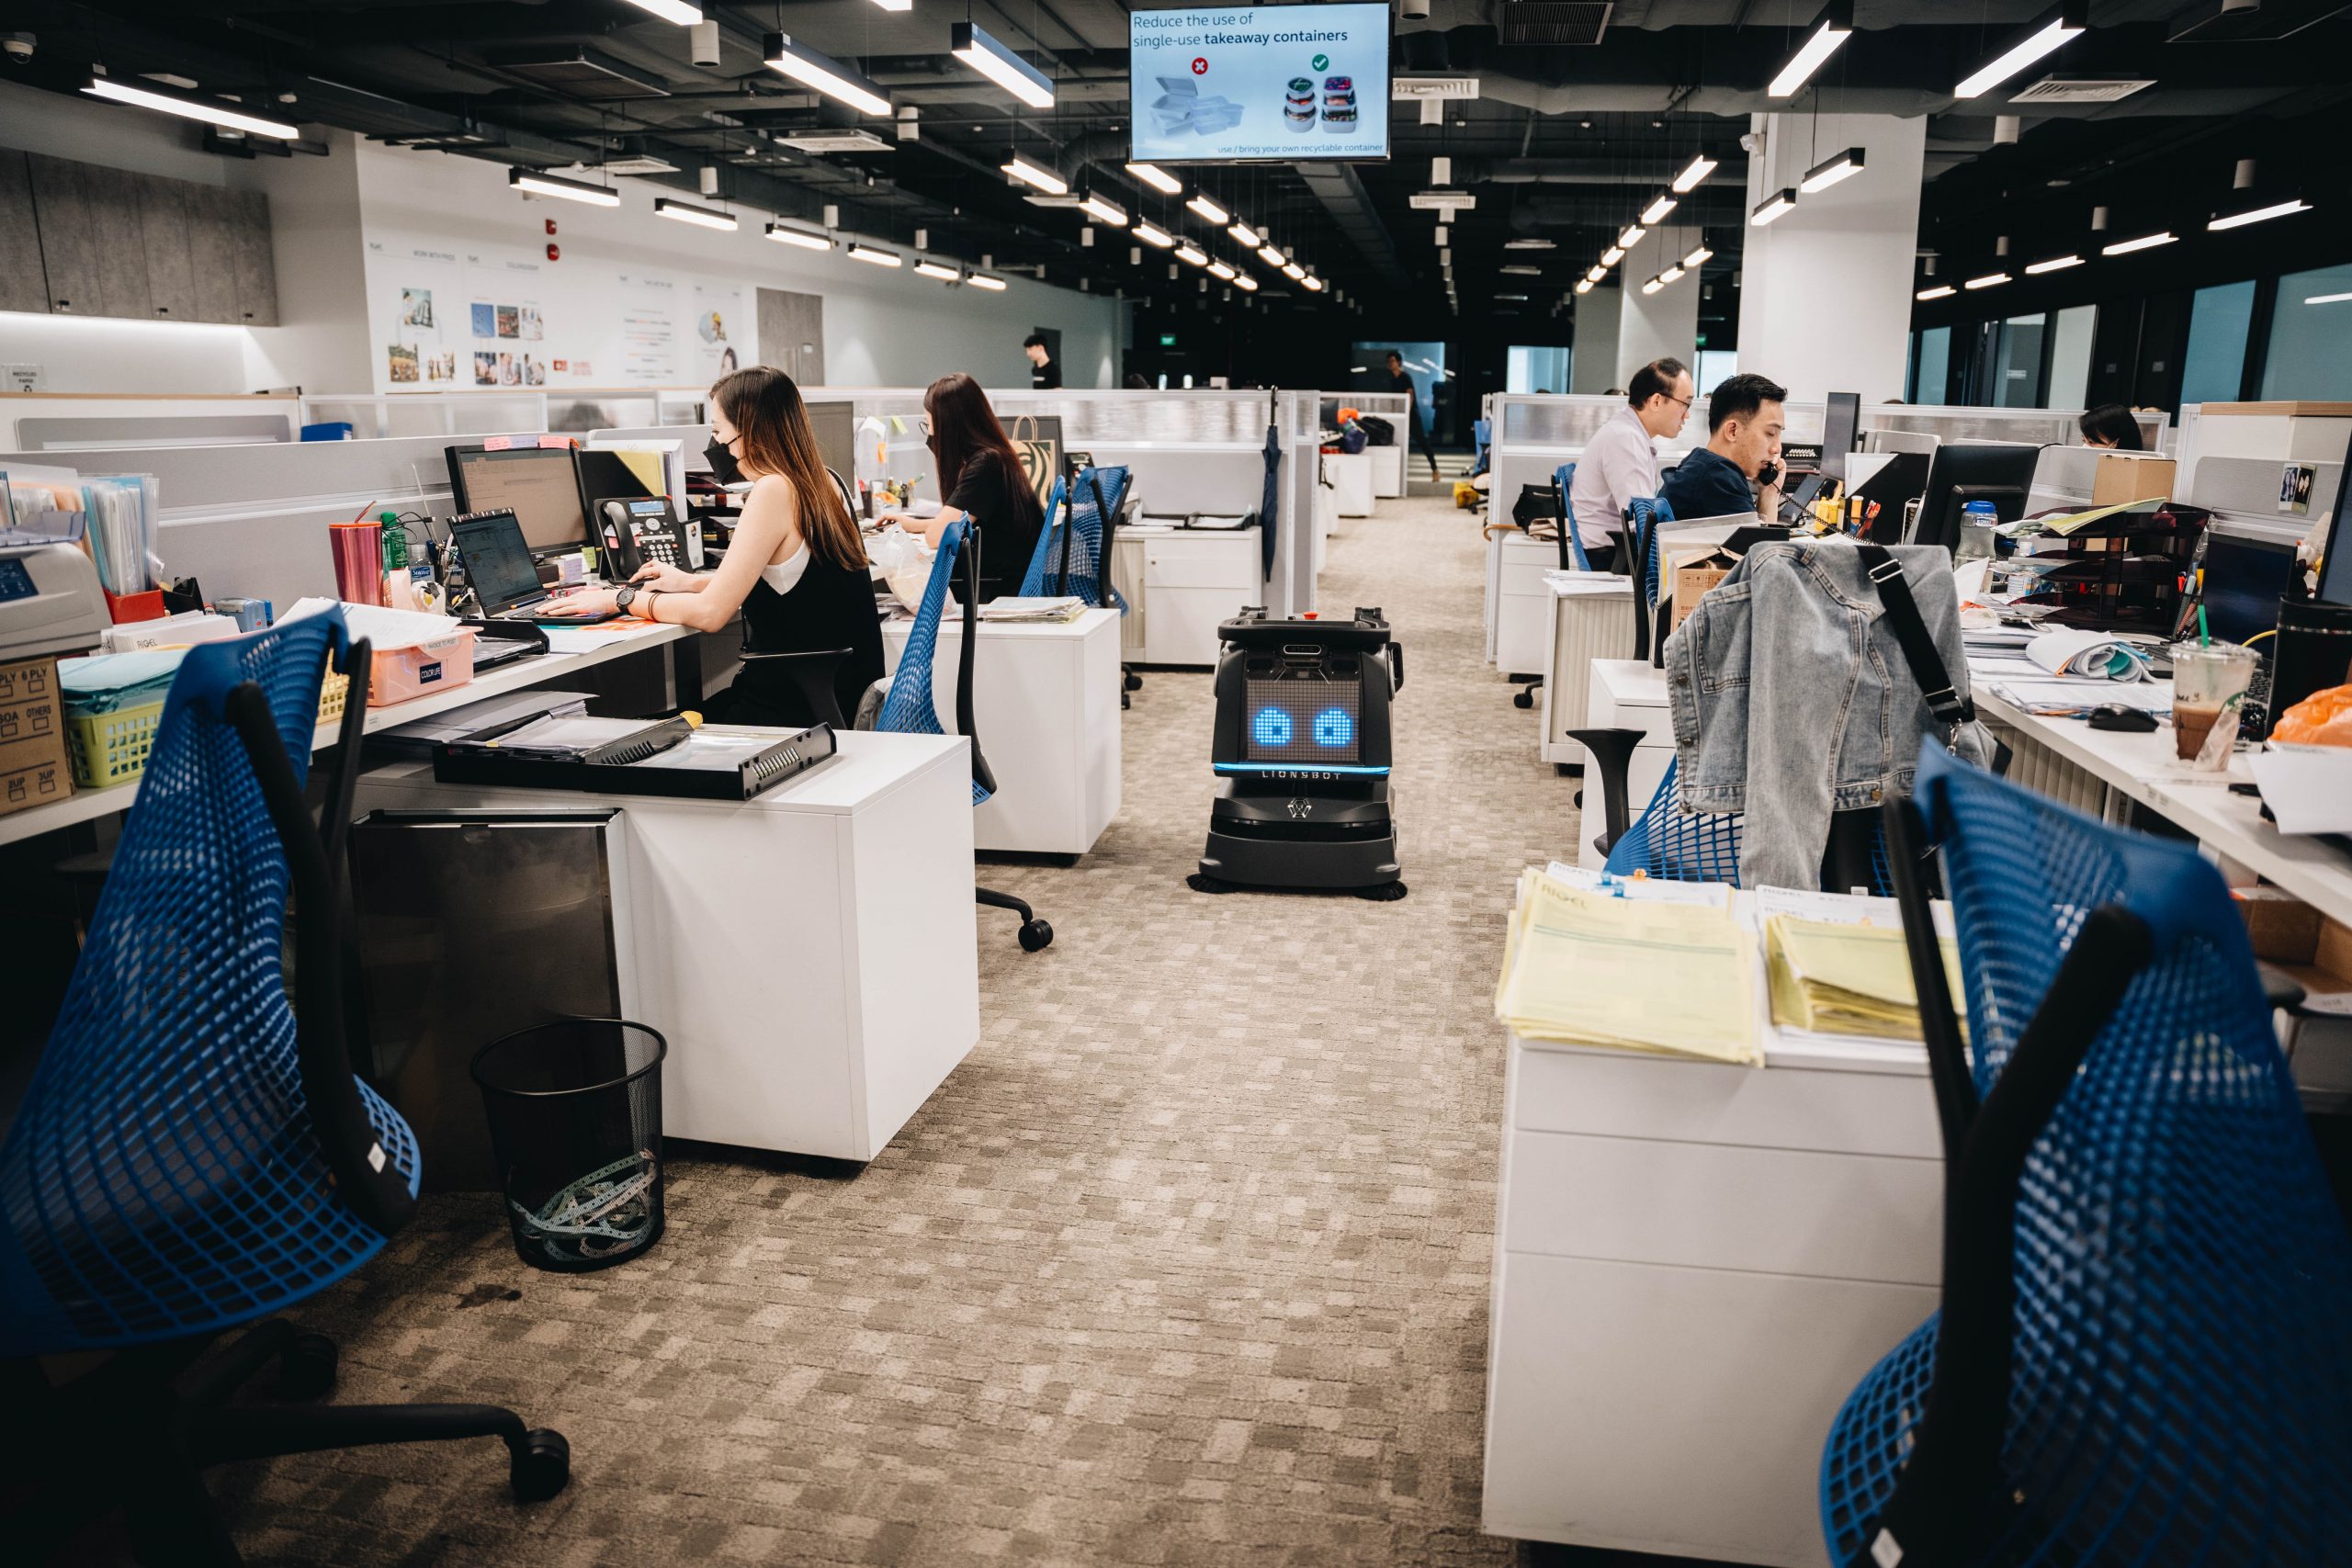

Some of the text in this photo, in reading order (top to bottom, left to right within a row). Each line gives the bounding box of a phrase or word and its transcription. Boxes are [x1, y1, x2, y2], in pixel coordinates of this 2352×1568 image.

[1134, 12, 1254, 28] Reduce the use of
[1134, 29, 1348, 50] single-use takeaway containers
[1239, 145, 1261, 154] bring
[1262, 146, 1280, 154] your
[1301, 144, 1342, 154] recyclable
[1344, 144, 1384, 152] container
[29, 668, 47, 679] PLY
[27, 705, 51, 718] OTHERS
[39, 769, 55, 781] 3UP
[1261, 771, 1341, 780] LIONSBOT
[8, 777, 26, 789] 2UP
